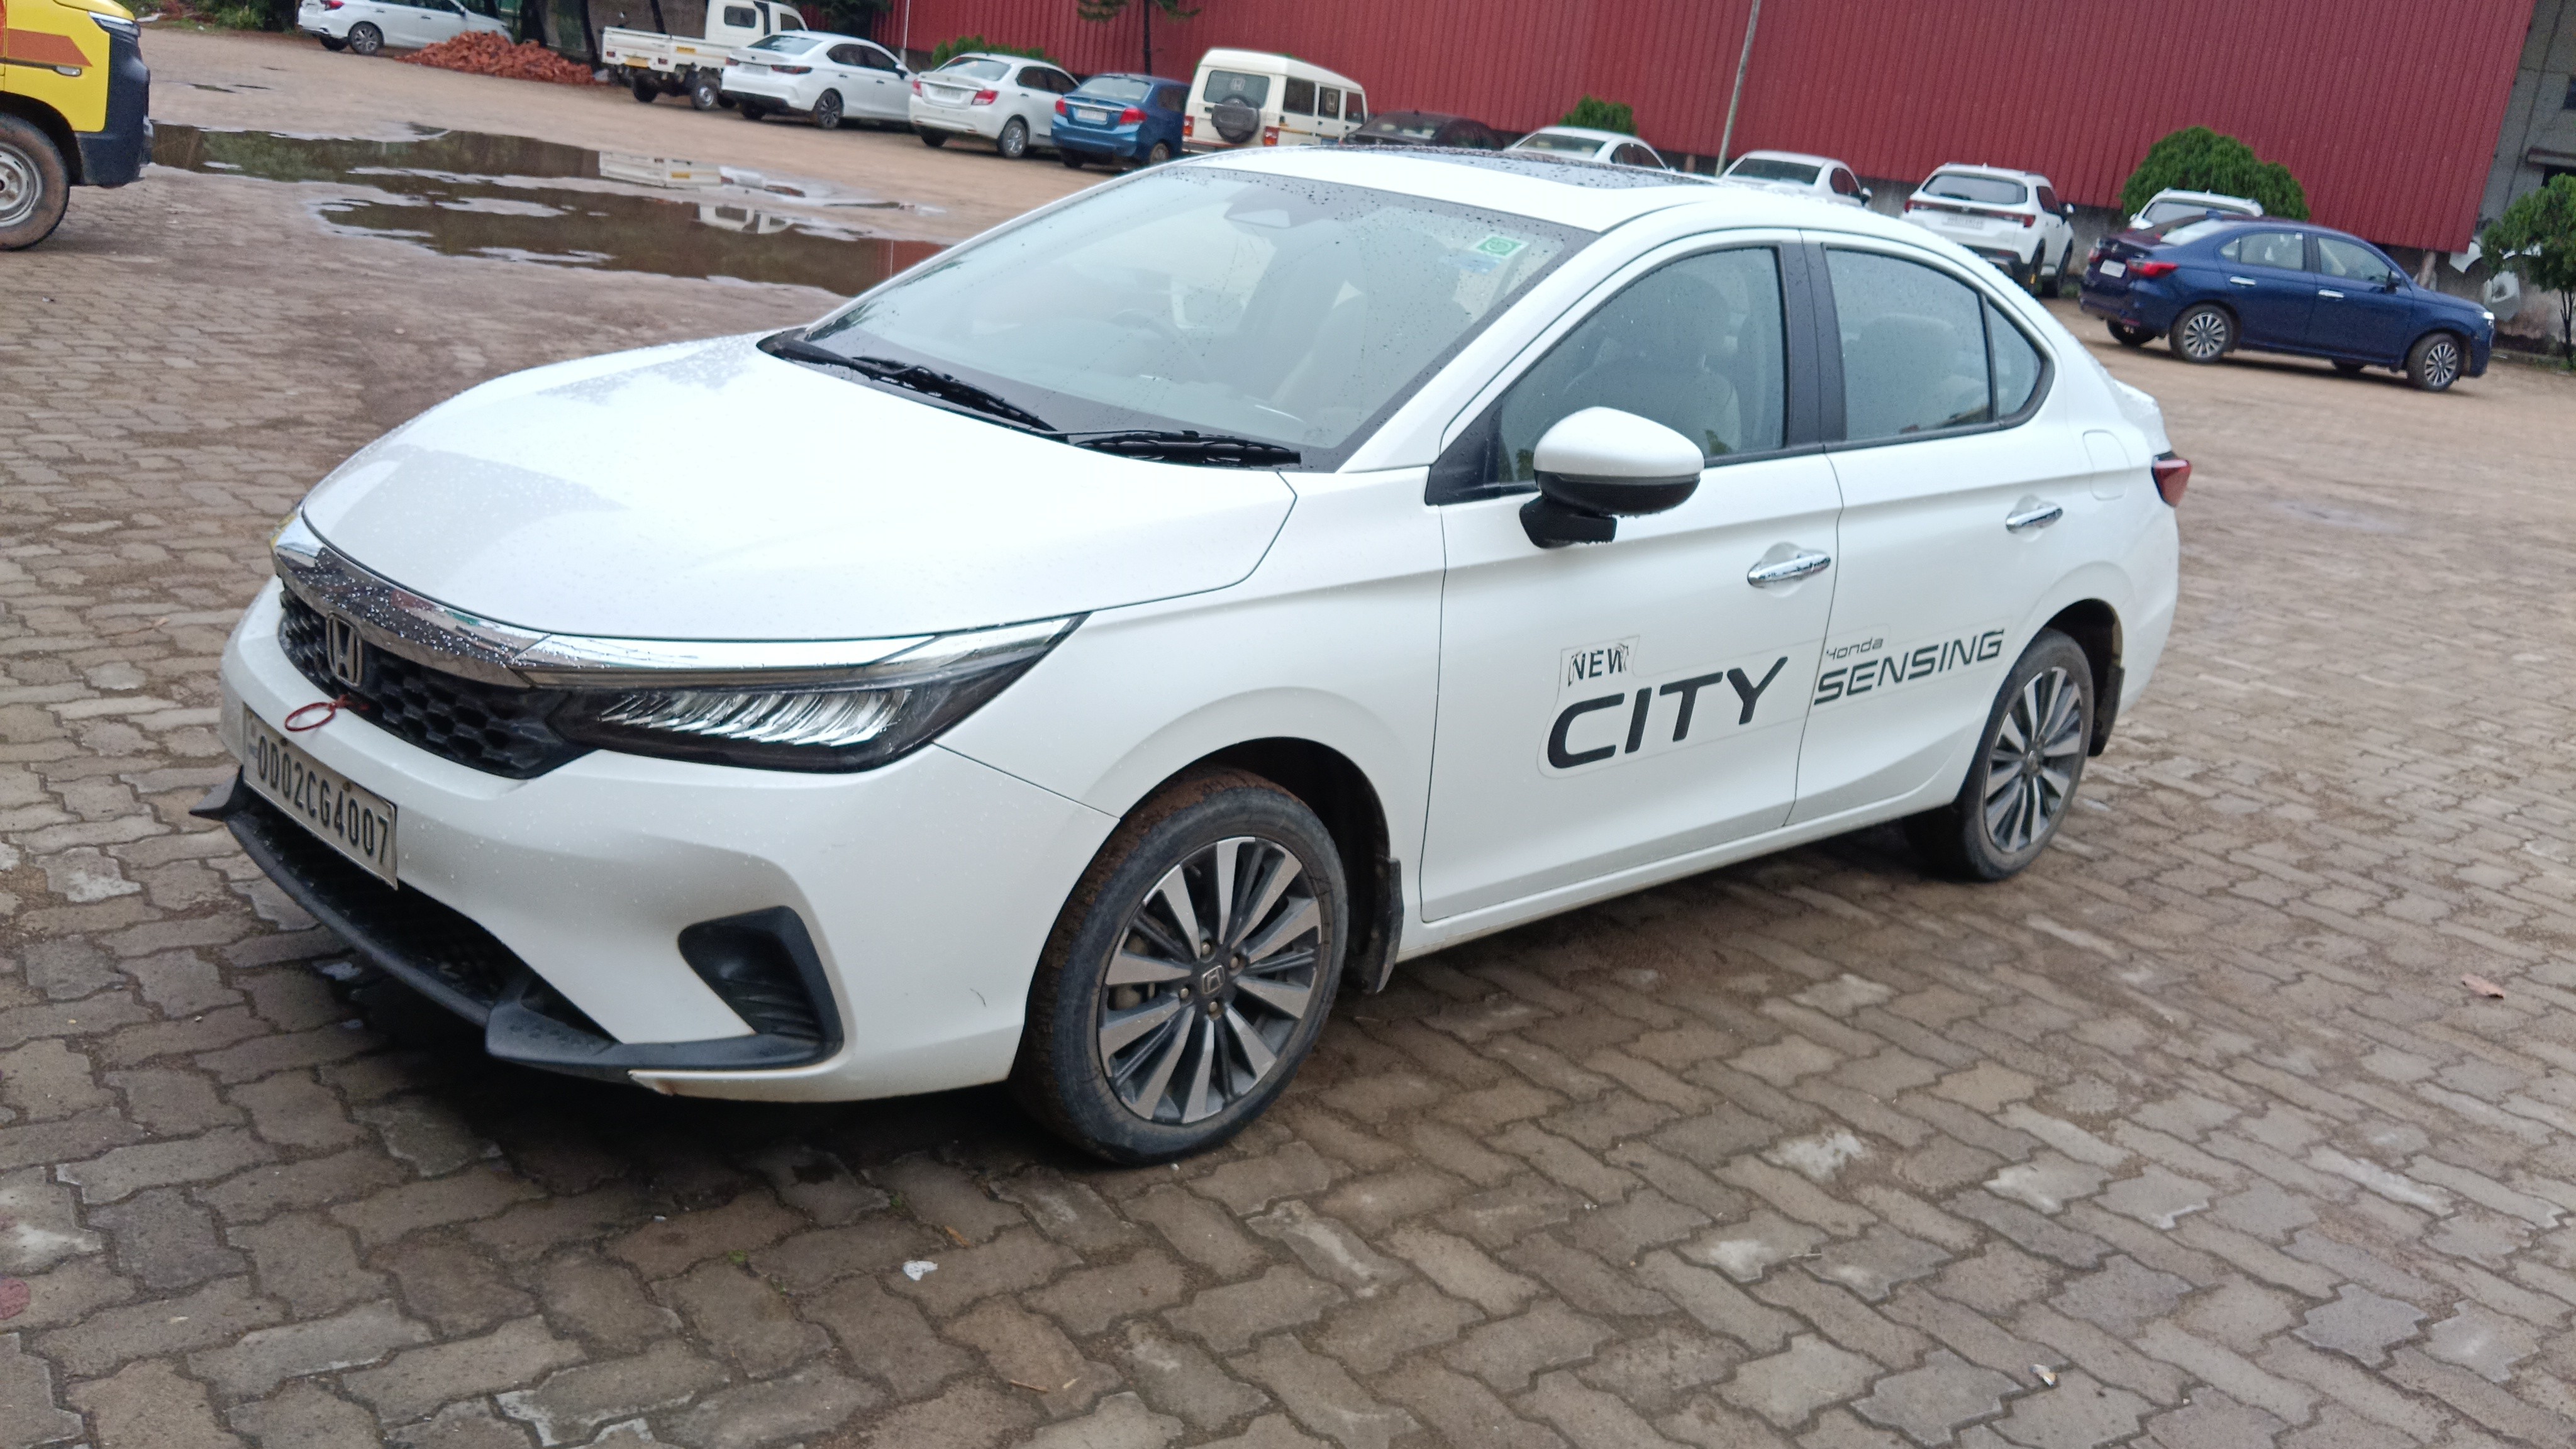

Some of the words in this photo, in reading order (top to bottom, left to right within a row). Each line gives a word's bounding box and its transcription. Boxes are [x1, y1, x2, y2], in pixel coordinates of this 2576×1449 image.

[1568, 643, 1629, 687] NEW
[1814, 628, 2005, 706] SENSING
[1547, 655, 1788, 769] CITY
